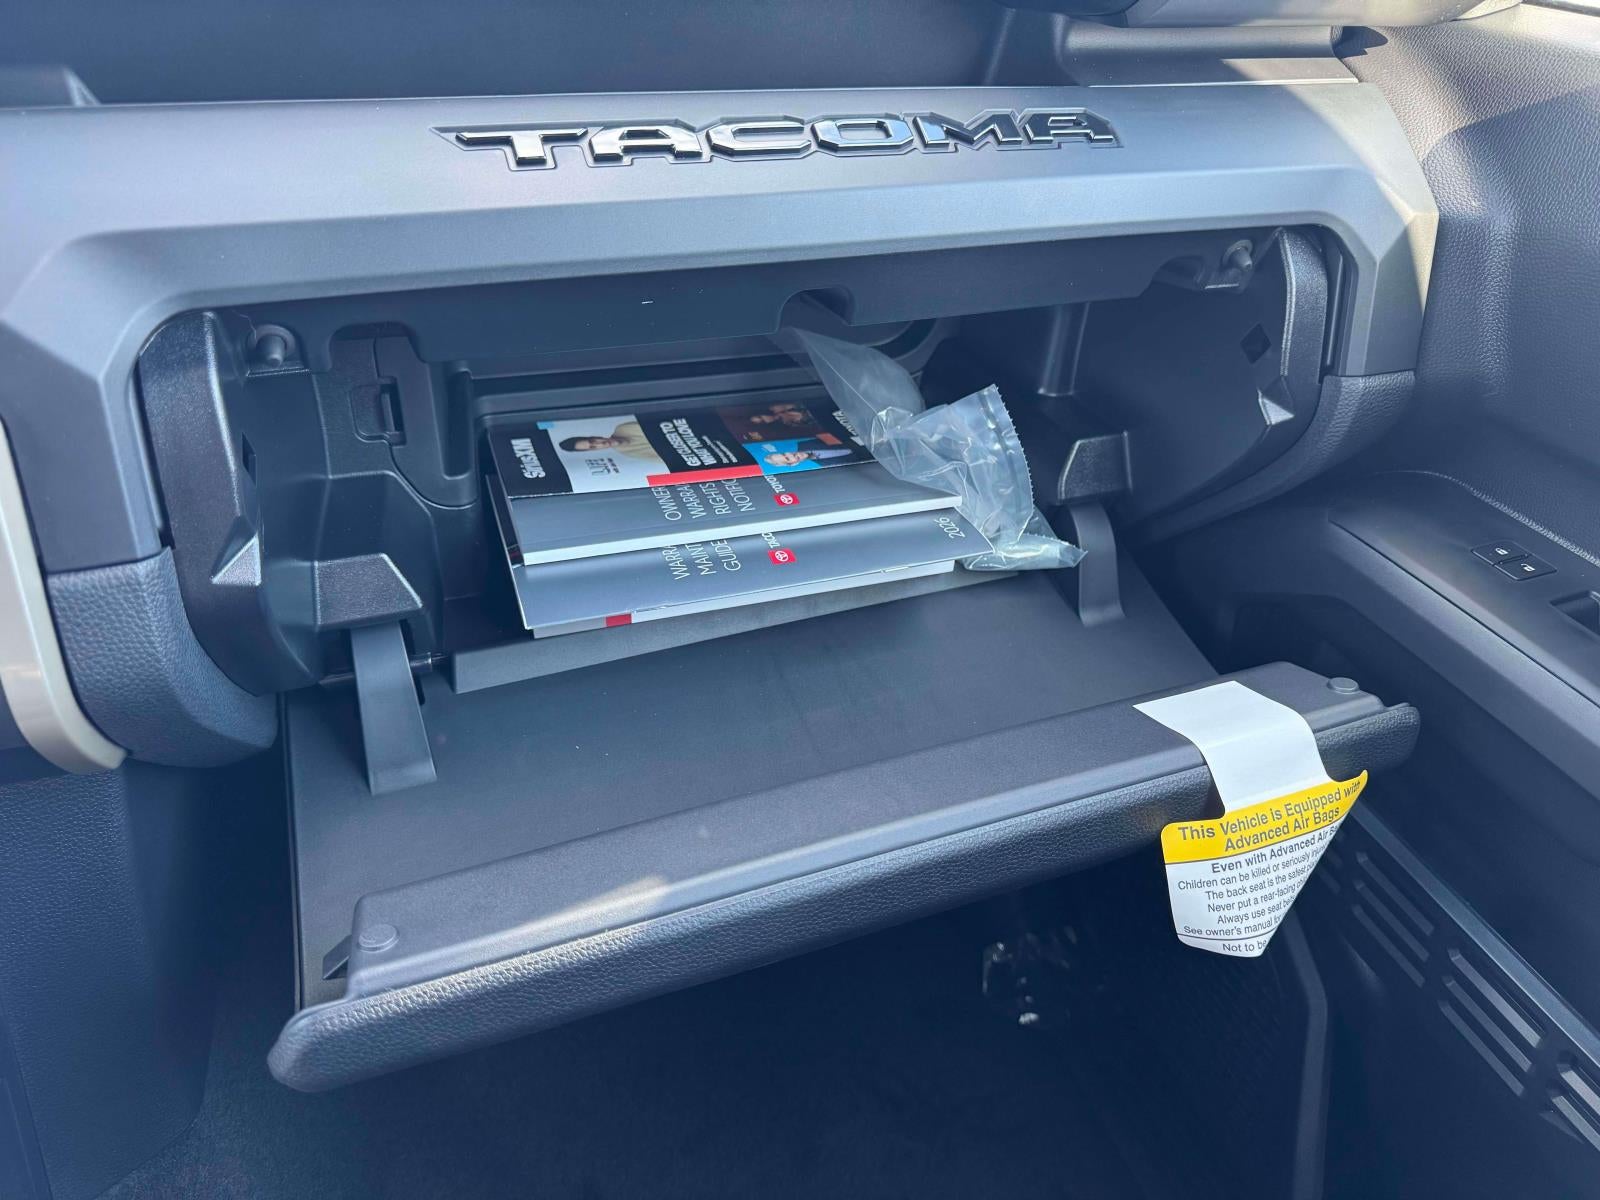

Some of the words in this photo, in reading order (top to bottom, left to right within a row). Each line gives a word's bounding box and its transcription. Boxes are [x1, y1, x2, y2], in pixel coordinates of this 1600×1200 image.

[450, 108, 1116, 168] TACOMA
[660, 422, 676, 433] TO
[673, 418, 695, 437] LOVE
[683, 436, 704, 449] YOU
[511, 438, 546, 478] SiriusXM
[666, 432, 692, 454] CLOSER
[694, 448, 717, 466] WHAT
[681, 454, 702, 466] GET
[700, 482, 732, 515] RIGHTS
[933, 516, 965, 538] 2026
[684, 543, 717, 576] MAINT
[711, 539, 742, 571] GUIDE
[1178, 825, 1215, 840] This
[1220, 813, 1268, 835] Vehicle
[1270, 808, 1283, 821] is
[1284, 788, 1342, 816] Equipped
[1225, 822, 1290, 852] Advanced
[1293, 816, 1310, 832] Air
[1313, 807, 1340, 825] Bags
[1211, 861, 1242, 873] Even
[1245, 852, 1267, 867] with
[1270, 834, 1316, 860] Advanced
[1317, 830, 1329, 842] Air
[1178, 879, 1218, 890] Children
[1220, 875, 1237, 885] can
[1239, 872, 1250, 882] be
[1251, 863, 1271, 879] killed
[1272, 863, 1280, 872] or
[1281, 851, 1311, 870] seriously
[1204, 891, 1224, 901] The
[1226, 885, 1247, 898] back
[1249, 880, 1267, 892] seat
[1267, 878, 1274, 888] is
[1275, 874, 1287, 885] the
[1288, 865, 1307, 880] safest
[1207, 902, 1235, 913] Never
[1238, 898, 1252, 911] put
[1253, 897, 1259, 905] a
[1260, 883, 1296, 903] rear-facing
[1183, 925, 1203, 935] See
[1205, 926, 1242, 936] owner's
[1244, 917, 1273, 935] manual
[1217, 912, 1249, 925] Always
[1251, 908, 1266, 919] use
[1267, 902, 1282, 914] seat
[1222, 943, 1242, 952] Not
[1245, 943, 1255, 952] to
[1257, 939, 1267, 950] be
